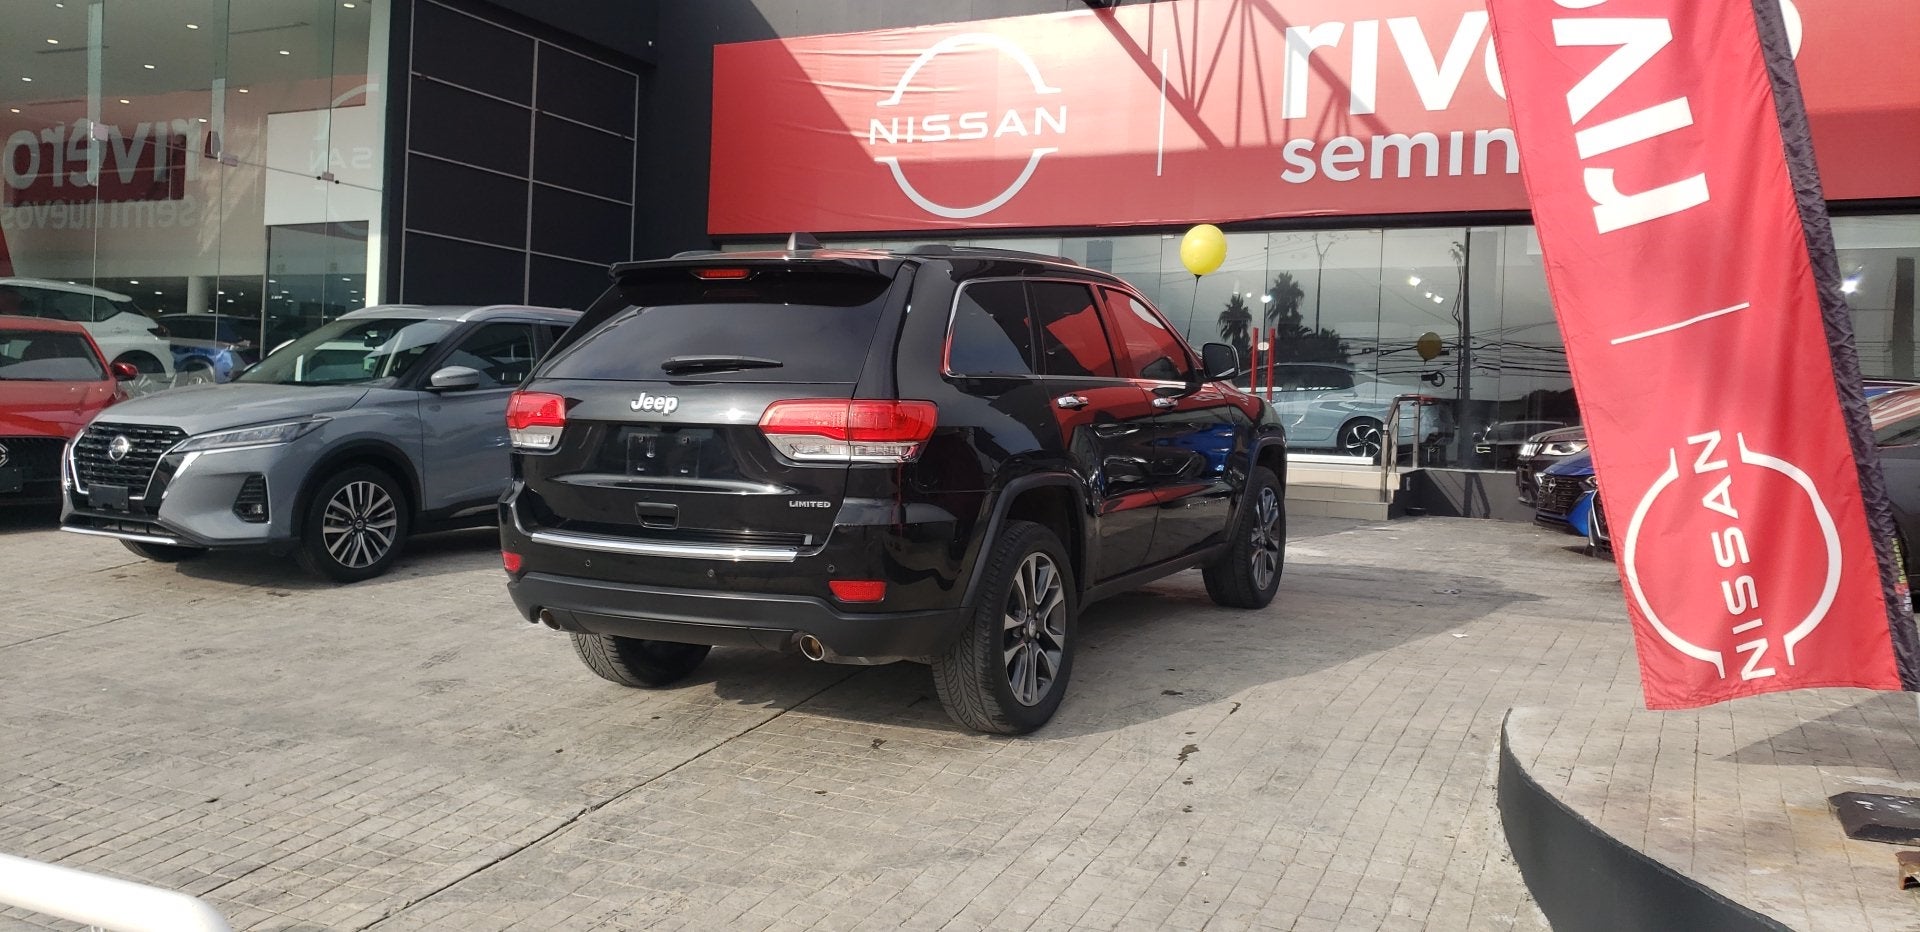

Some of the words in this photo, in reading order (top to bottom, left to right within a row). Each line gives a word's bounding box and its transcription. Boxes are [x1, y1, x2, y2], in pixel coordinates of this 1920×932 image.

[868, 105, 1068, 146] NISSAN
[631, 392, 677, 415] Jeep
[789, 500, 831, 509] LIMITED
[1686, 429, 1776, 682] NISSAN
